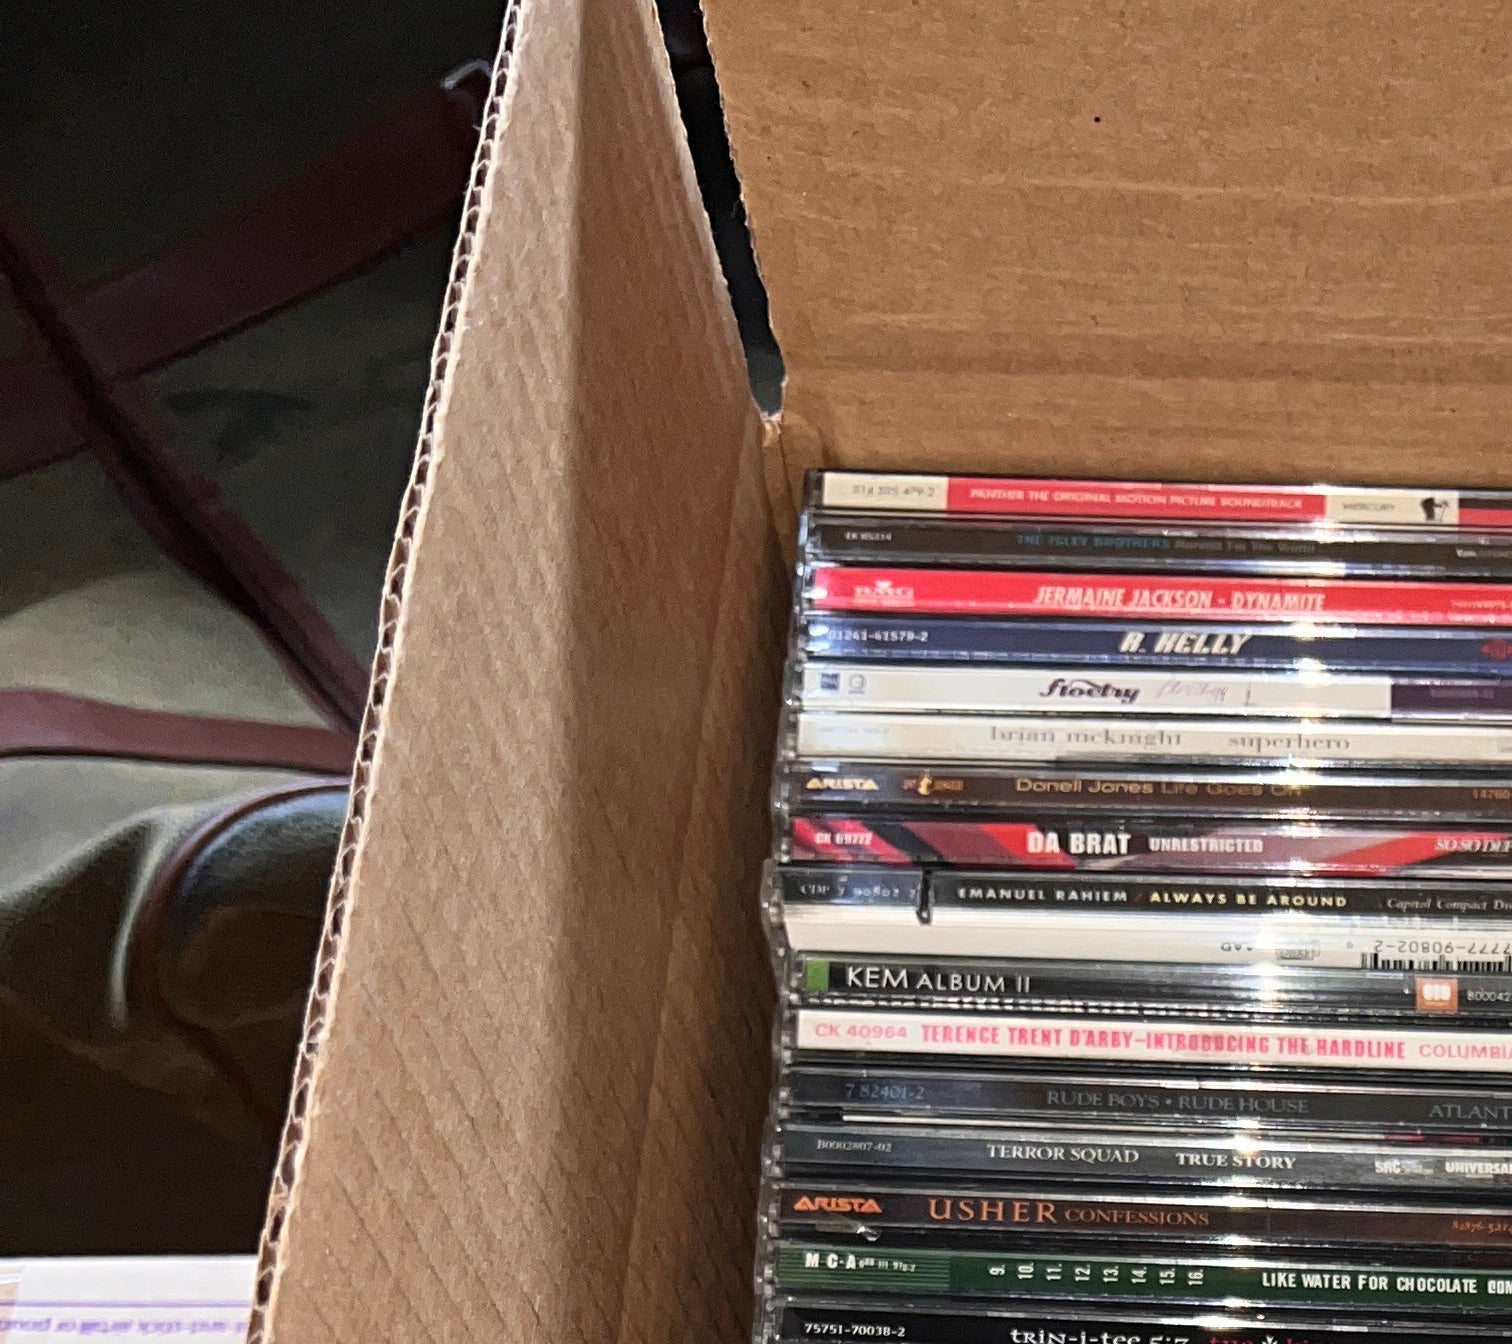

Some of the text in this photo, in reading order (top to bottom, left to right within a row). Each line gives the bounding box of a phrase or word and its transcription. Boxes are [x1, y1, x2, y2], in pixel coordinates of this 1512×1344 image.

[1036, 586, 1325, 611] JERMAINE JACKSON DYNAMITE
[991, 725, 1181, 747] brian mcknight
[806, 778, 879, 791] ARISTA
[1015, 778, 1154, 794] Donell Jones
[1028, 832, 1263, 855] DA BRAT UNRESTRICTED
[959, 888, 1347, 908] EMANUEL RAHIEM AROUND
[1436, 899, 1487, 912] Compact
[847, 967, 1005, 993] KEM ALBUM
[922, 1025, 999, 1044] TERENCE
[1008, 1027, 1061, 1047] TRENT
[987, 1144, 1297, 1169] TERROR SQUAD STORY
[794, 1195, 1057, 1224] ARISTA USHER
[1262, 1272, 1478, 1293] LIKE WATER CHOCOLATE
[804, 1323, 906, 1337] 75751-70038-2
